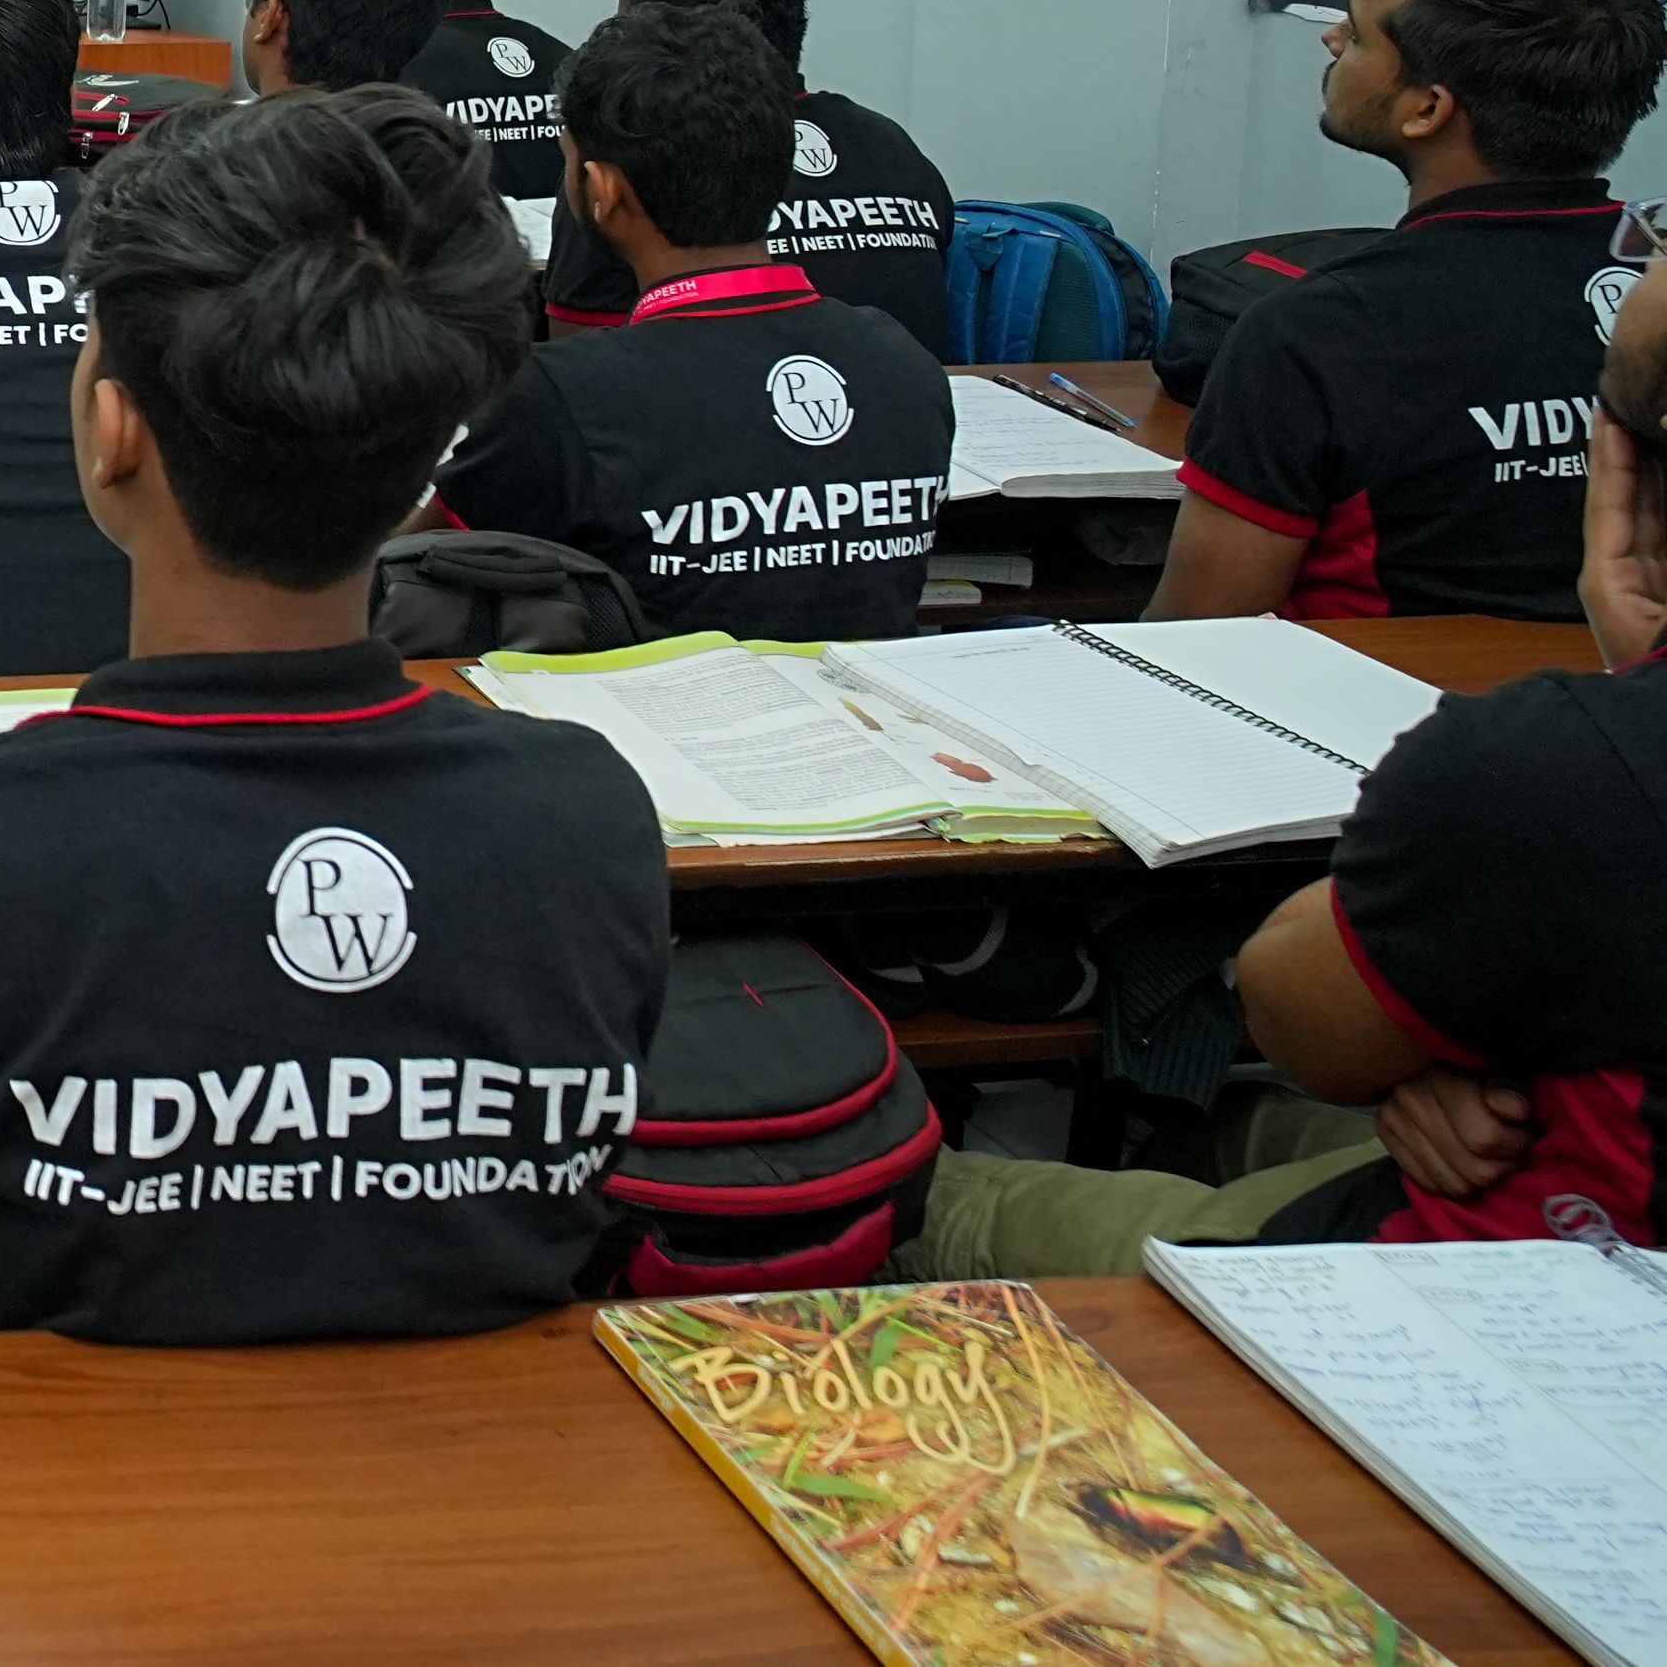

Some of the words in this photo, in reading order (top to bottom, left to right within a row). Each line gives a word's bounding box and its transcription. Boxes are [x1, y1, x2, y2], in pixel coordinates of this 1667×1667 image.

[444, 93, 561, 125] VIDYAPE
[499, 126, 528, 142] NEET
[768, 196, 940, 235] YAPEETH
[803, 234, 845, 253] NEET
[780, 371, 839, 434] PW
[1494, 455, 1582, 483] IIT-JEE
[649, 549, 749, 577] IIT-JEE
[767, 542, 824, 570] NEET
[295, 857, 395, 975] PW
[9, 1056, 638, 1159] VIDYAPEETH
[24, 1157, 182, 1217] IIT-JEE
[210, 1160, 322, 1203] NEET
[354, 1142, 614, 1199] FOUNDATION
[667, 1335, 1018, 1477] Biology
